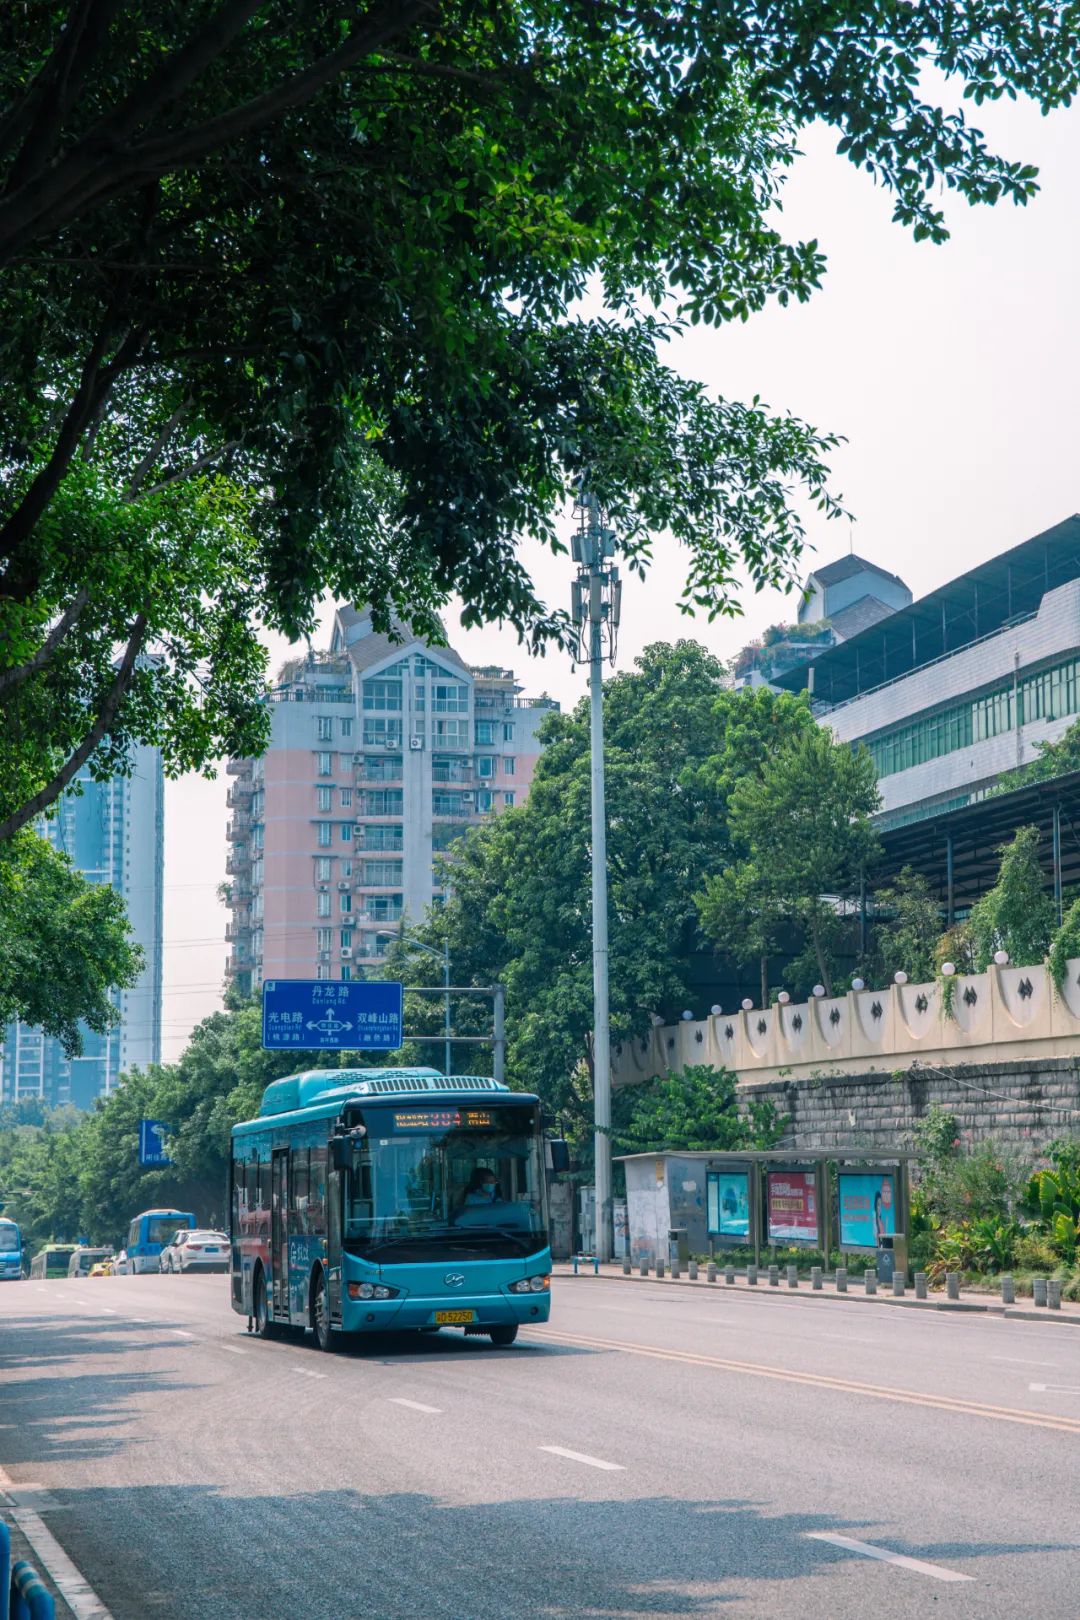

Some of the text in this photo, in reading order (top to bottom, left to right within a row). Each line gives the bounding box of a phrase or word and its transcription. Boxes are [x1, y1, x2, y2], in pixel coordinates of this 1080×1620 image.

[312, 985, 349, 997] 丹龙路
[268, 1011, 304, 1023] 光电路
[357, 1012, 399, 1024] 双峰山路
